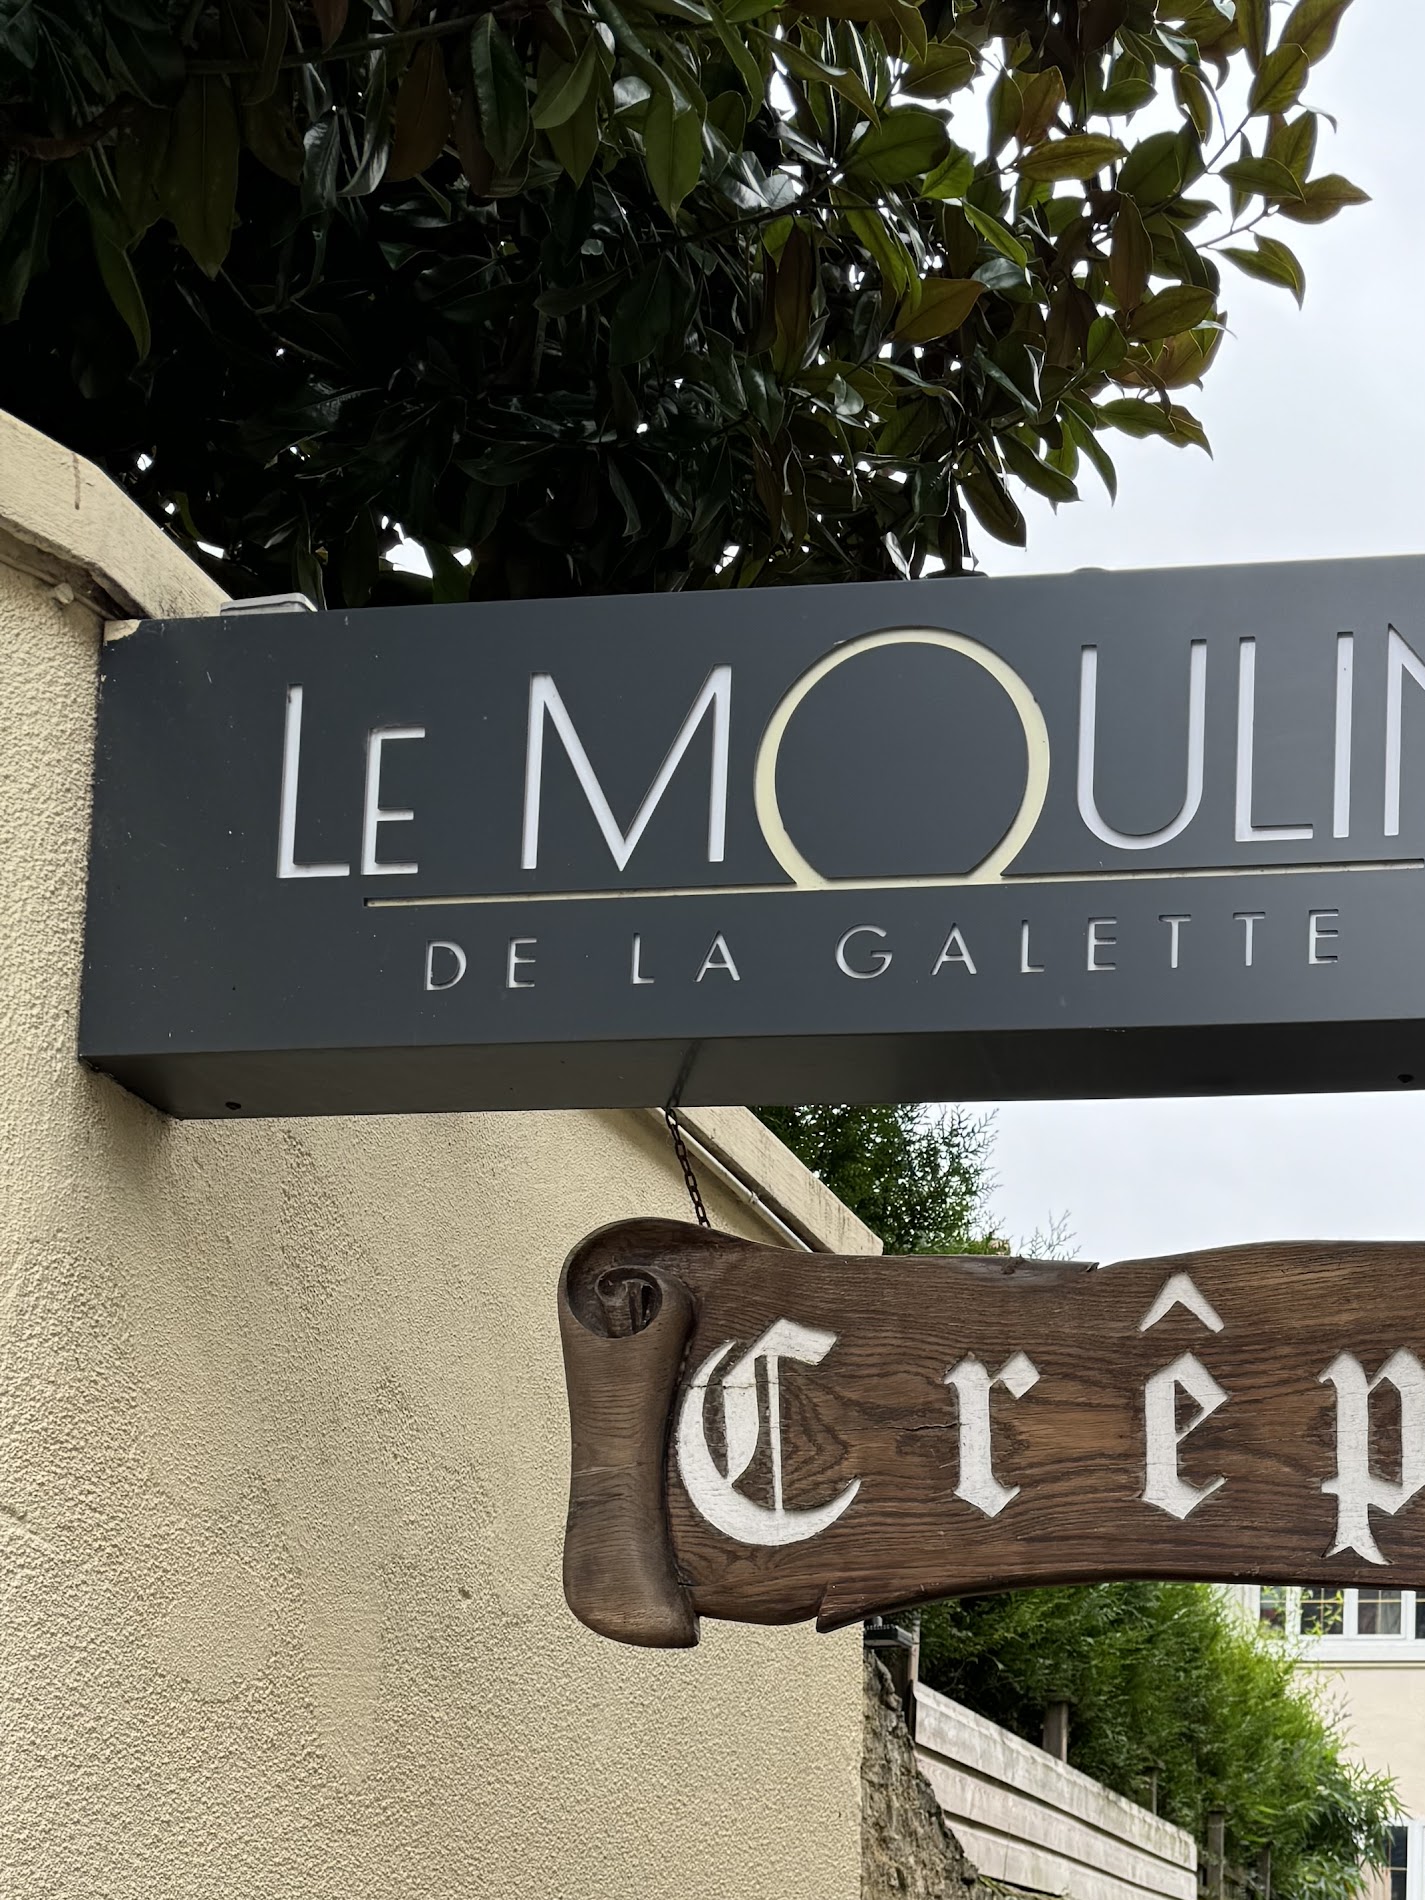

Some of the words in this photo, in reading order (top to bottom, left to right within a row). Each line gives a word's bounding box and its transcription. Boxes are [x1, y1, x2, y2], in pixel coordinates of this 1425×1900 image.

[276, 682, 426, 879] LE
[424, 936, 538, 991] DE
[631, 931, 741, 984] LA
[834, 908, 1340, 980] GALETTE
